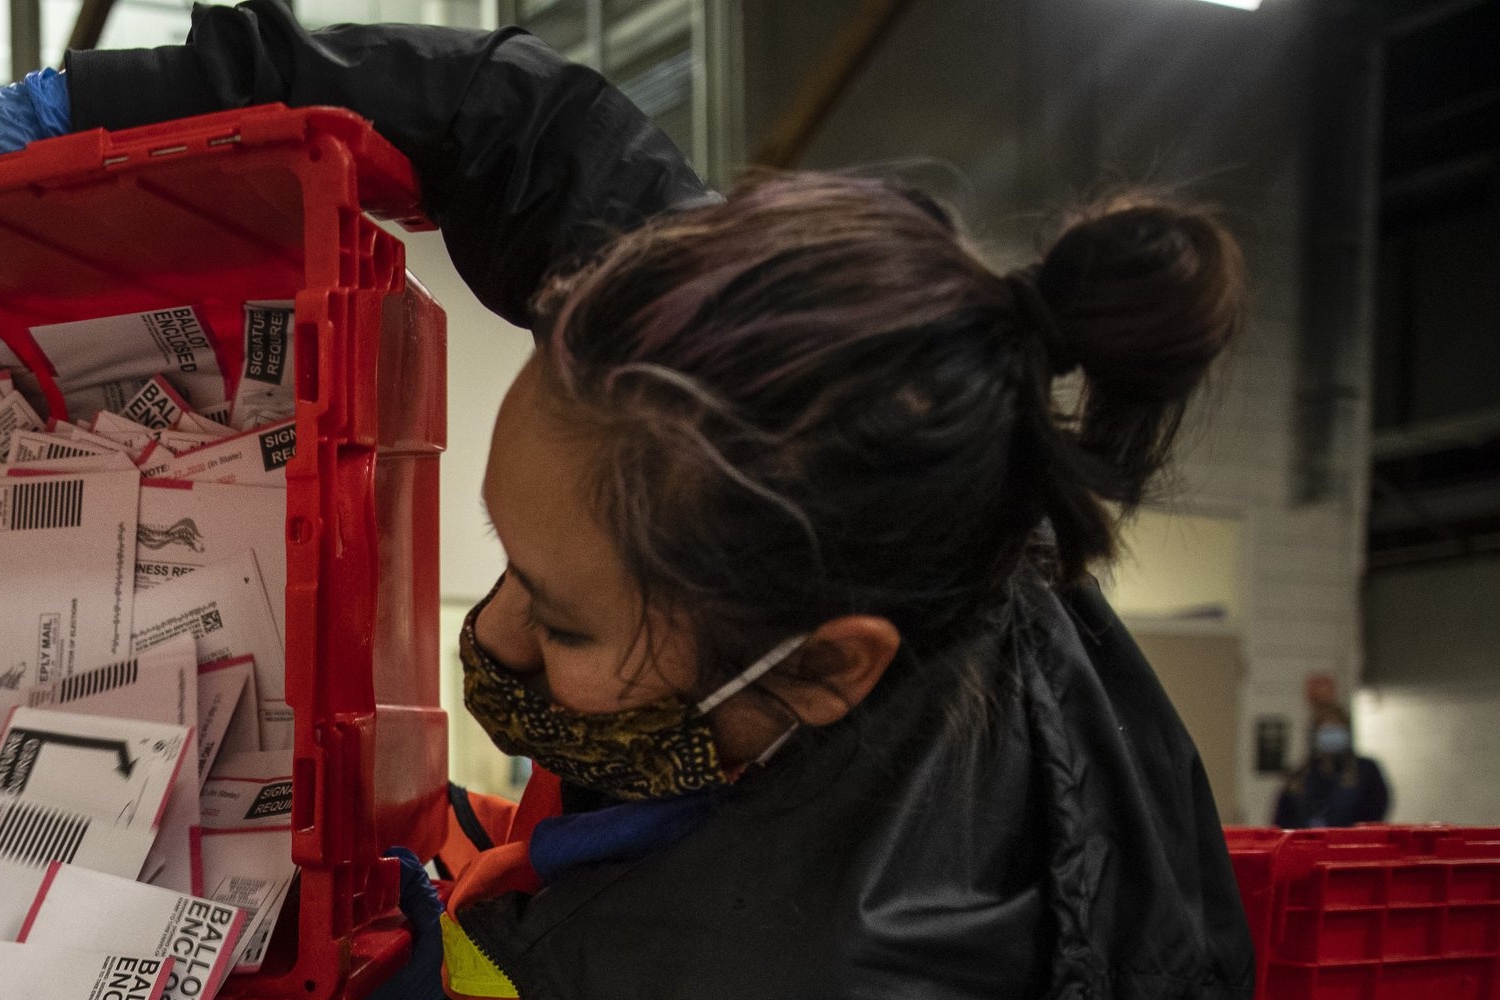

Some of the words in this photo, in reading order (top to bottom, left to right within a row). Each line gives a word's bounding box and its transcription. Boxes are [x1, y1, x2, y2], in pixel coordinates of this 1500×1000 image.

[154, 311, 198, 373] ENCLOSED
[173, 308, 209, 350] BALLOT
[41, 621, 52, 650] MAIL
